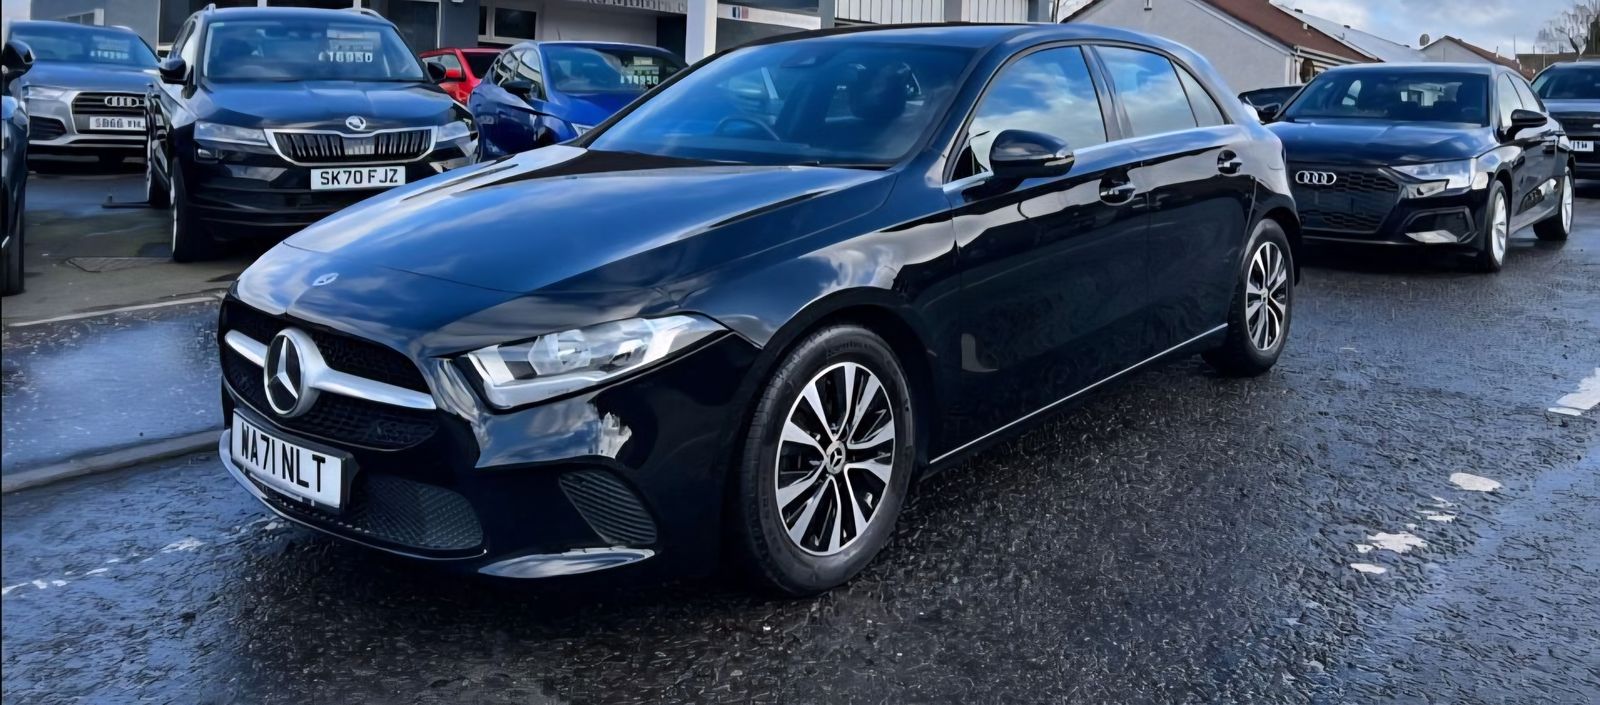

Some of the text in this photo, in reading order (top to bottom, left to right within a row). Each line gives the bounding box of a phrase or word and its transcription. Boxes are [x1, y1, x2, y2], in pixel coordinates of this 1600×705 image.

[320, 168, 398, 185] SK70 FJZ
[241, 421, 326, 493] WA71 NLT
